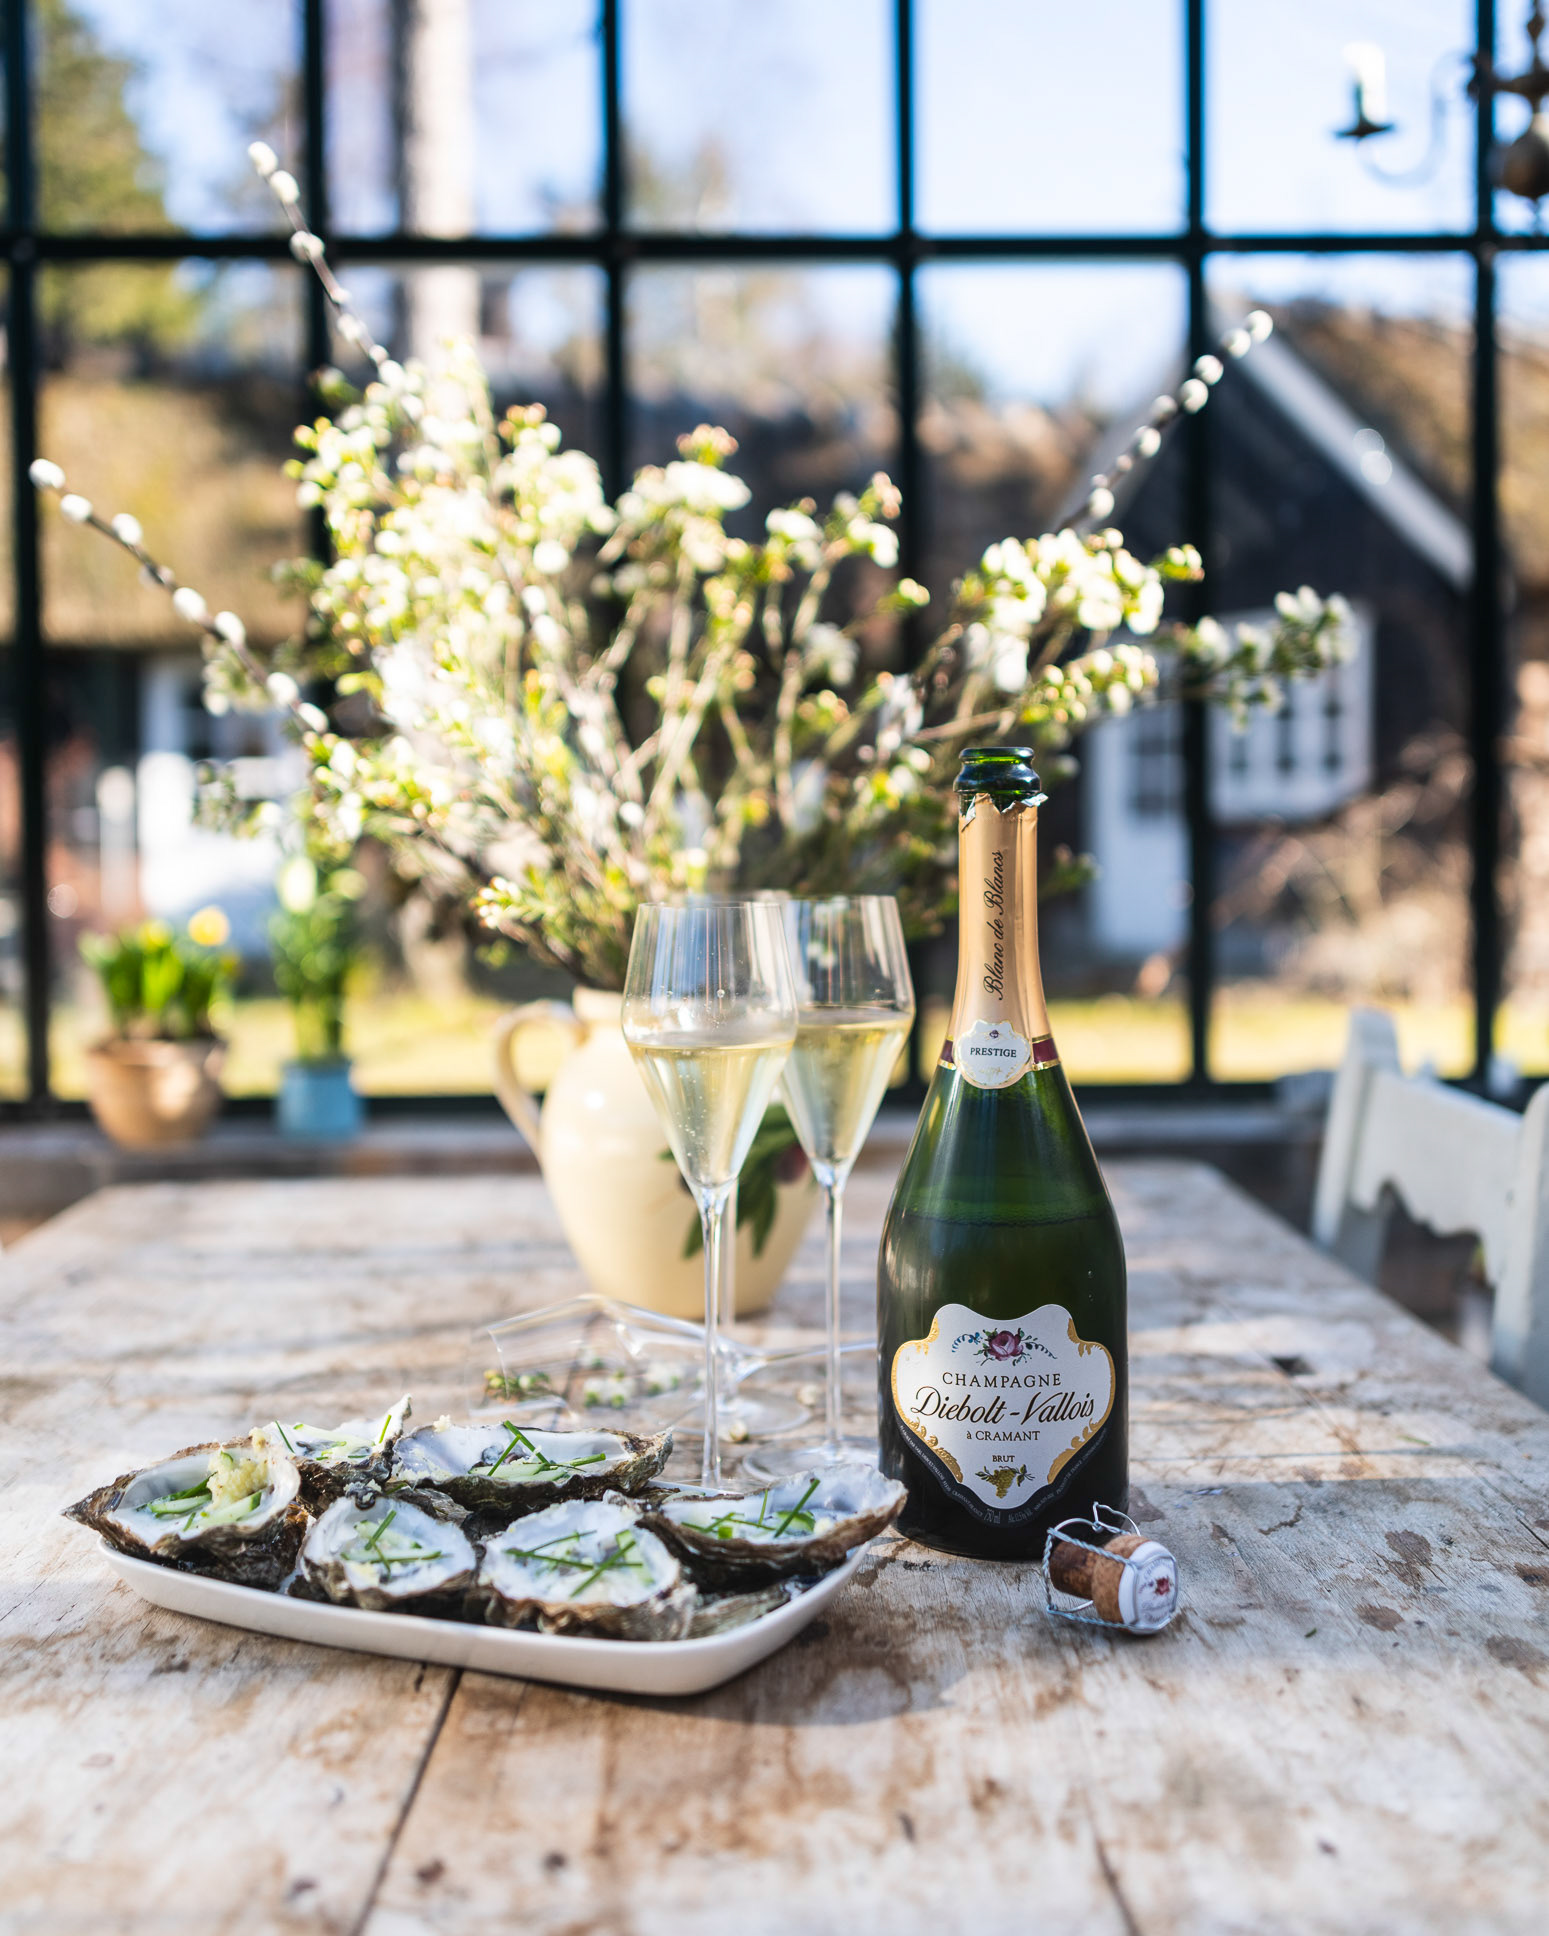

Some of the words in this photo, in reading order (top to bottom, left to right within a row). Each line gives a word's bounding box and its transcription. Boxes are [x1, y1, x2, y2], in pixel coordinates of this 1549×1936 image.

[983, 850, 1004, 916] Blancs
[986, 917, 1004, 942] de
[983, 942, 1004, 1000] Blanc
[970, 1047, 1017, 1058] PRESTIGE
[942, 1372, 1062, 1388] CHAMPAGNE
[966, 1430, 972, 1440] à
[975, 1430, 1041, 1442] CRAMANT
[992, 1455, 1015, 1463] BRUT
